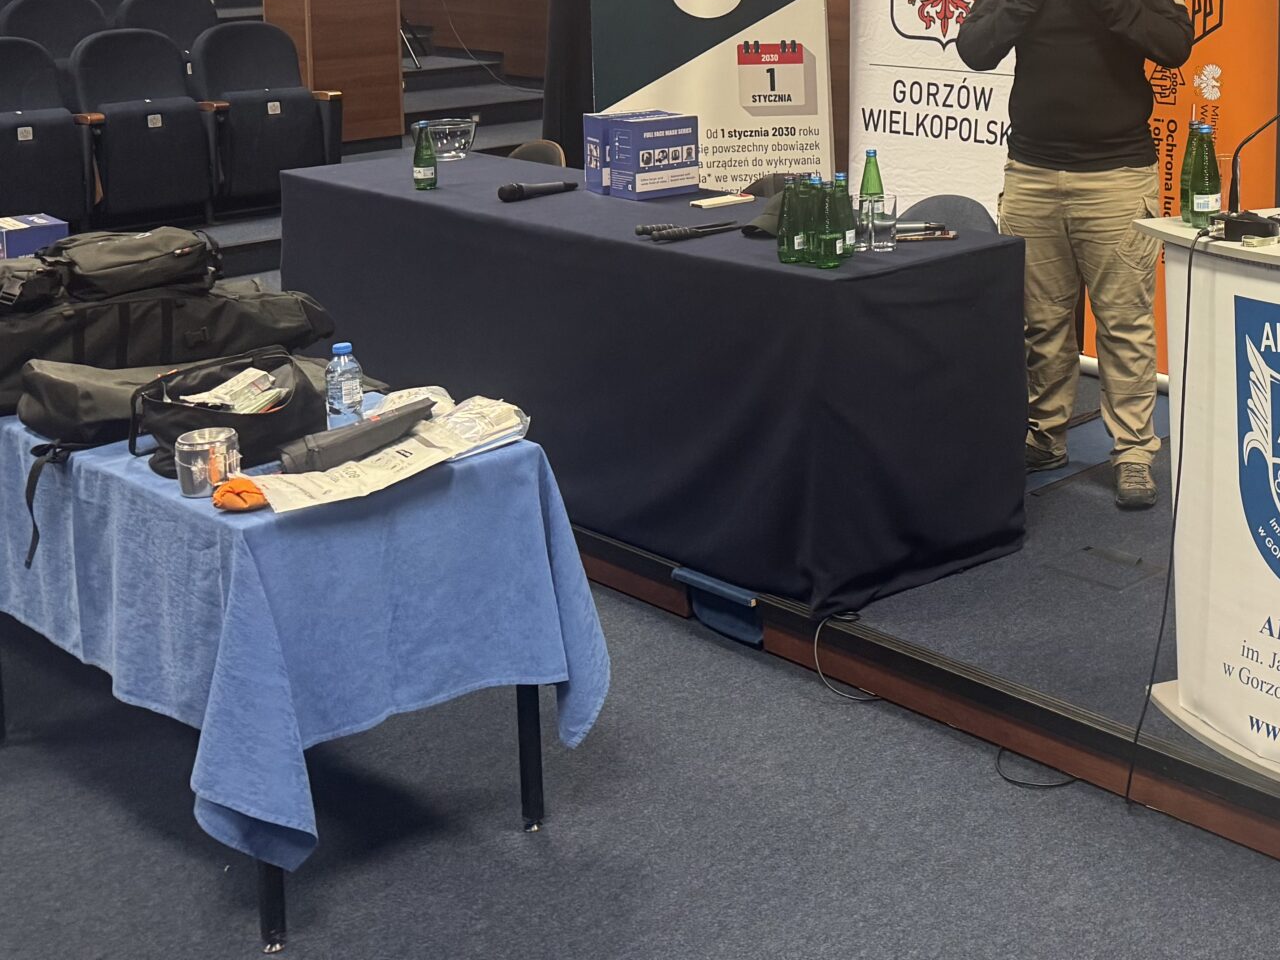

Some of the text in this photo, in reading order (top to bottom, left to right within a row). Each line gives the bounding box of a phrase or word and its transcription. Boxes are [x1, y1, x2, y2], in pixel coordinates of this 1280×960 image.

[761, 54, 779, 63] 2030
[765, 68, 776, 92] 1
[751, 93, 793, 104] STYCZNIA
[892, 78, 994, 112] GORZÓW
[861, 106, 1013, 147] WIELKOPOLSK
[1210, 105, 1220, 146] Minist
[706, 126, 820, 142] Od 1 stycznia 2030 roku
[712, 143, 769, 157] powszechny
[771, 141, 821, 153] obowiązek
[1164, 119, 1178, 192] Ochrona
[706, 156, 749, 170] urządzeń
[751, 157, 764, 167] do
[765, 155, 821, 169] wykrywania
[714, 175, 729, 183] we
[1241, 640, 1264, 665] im.
[1222, 662, 1235, 678] w
